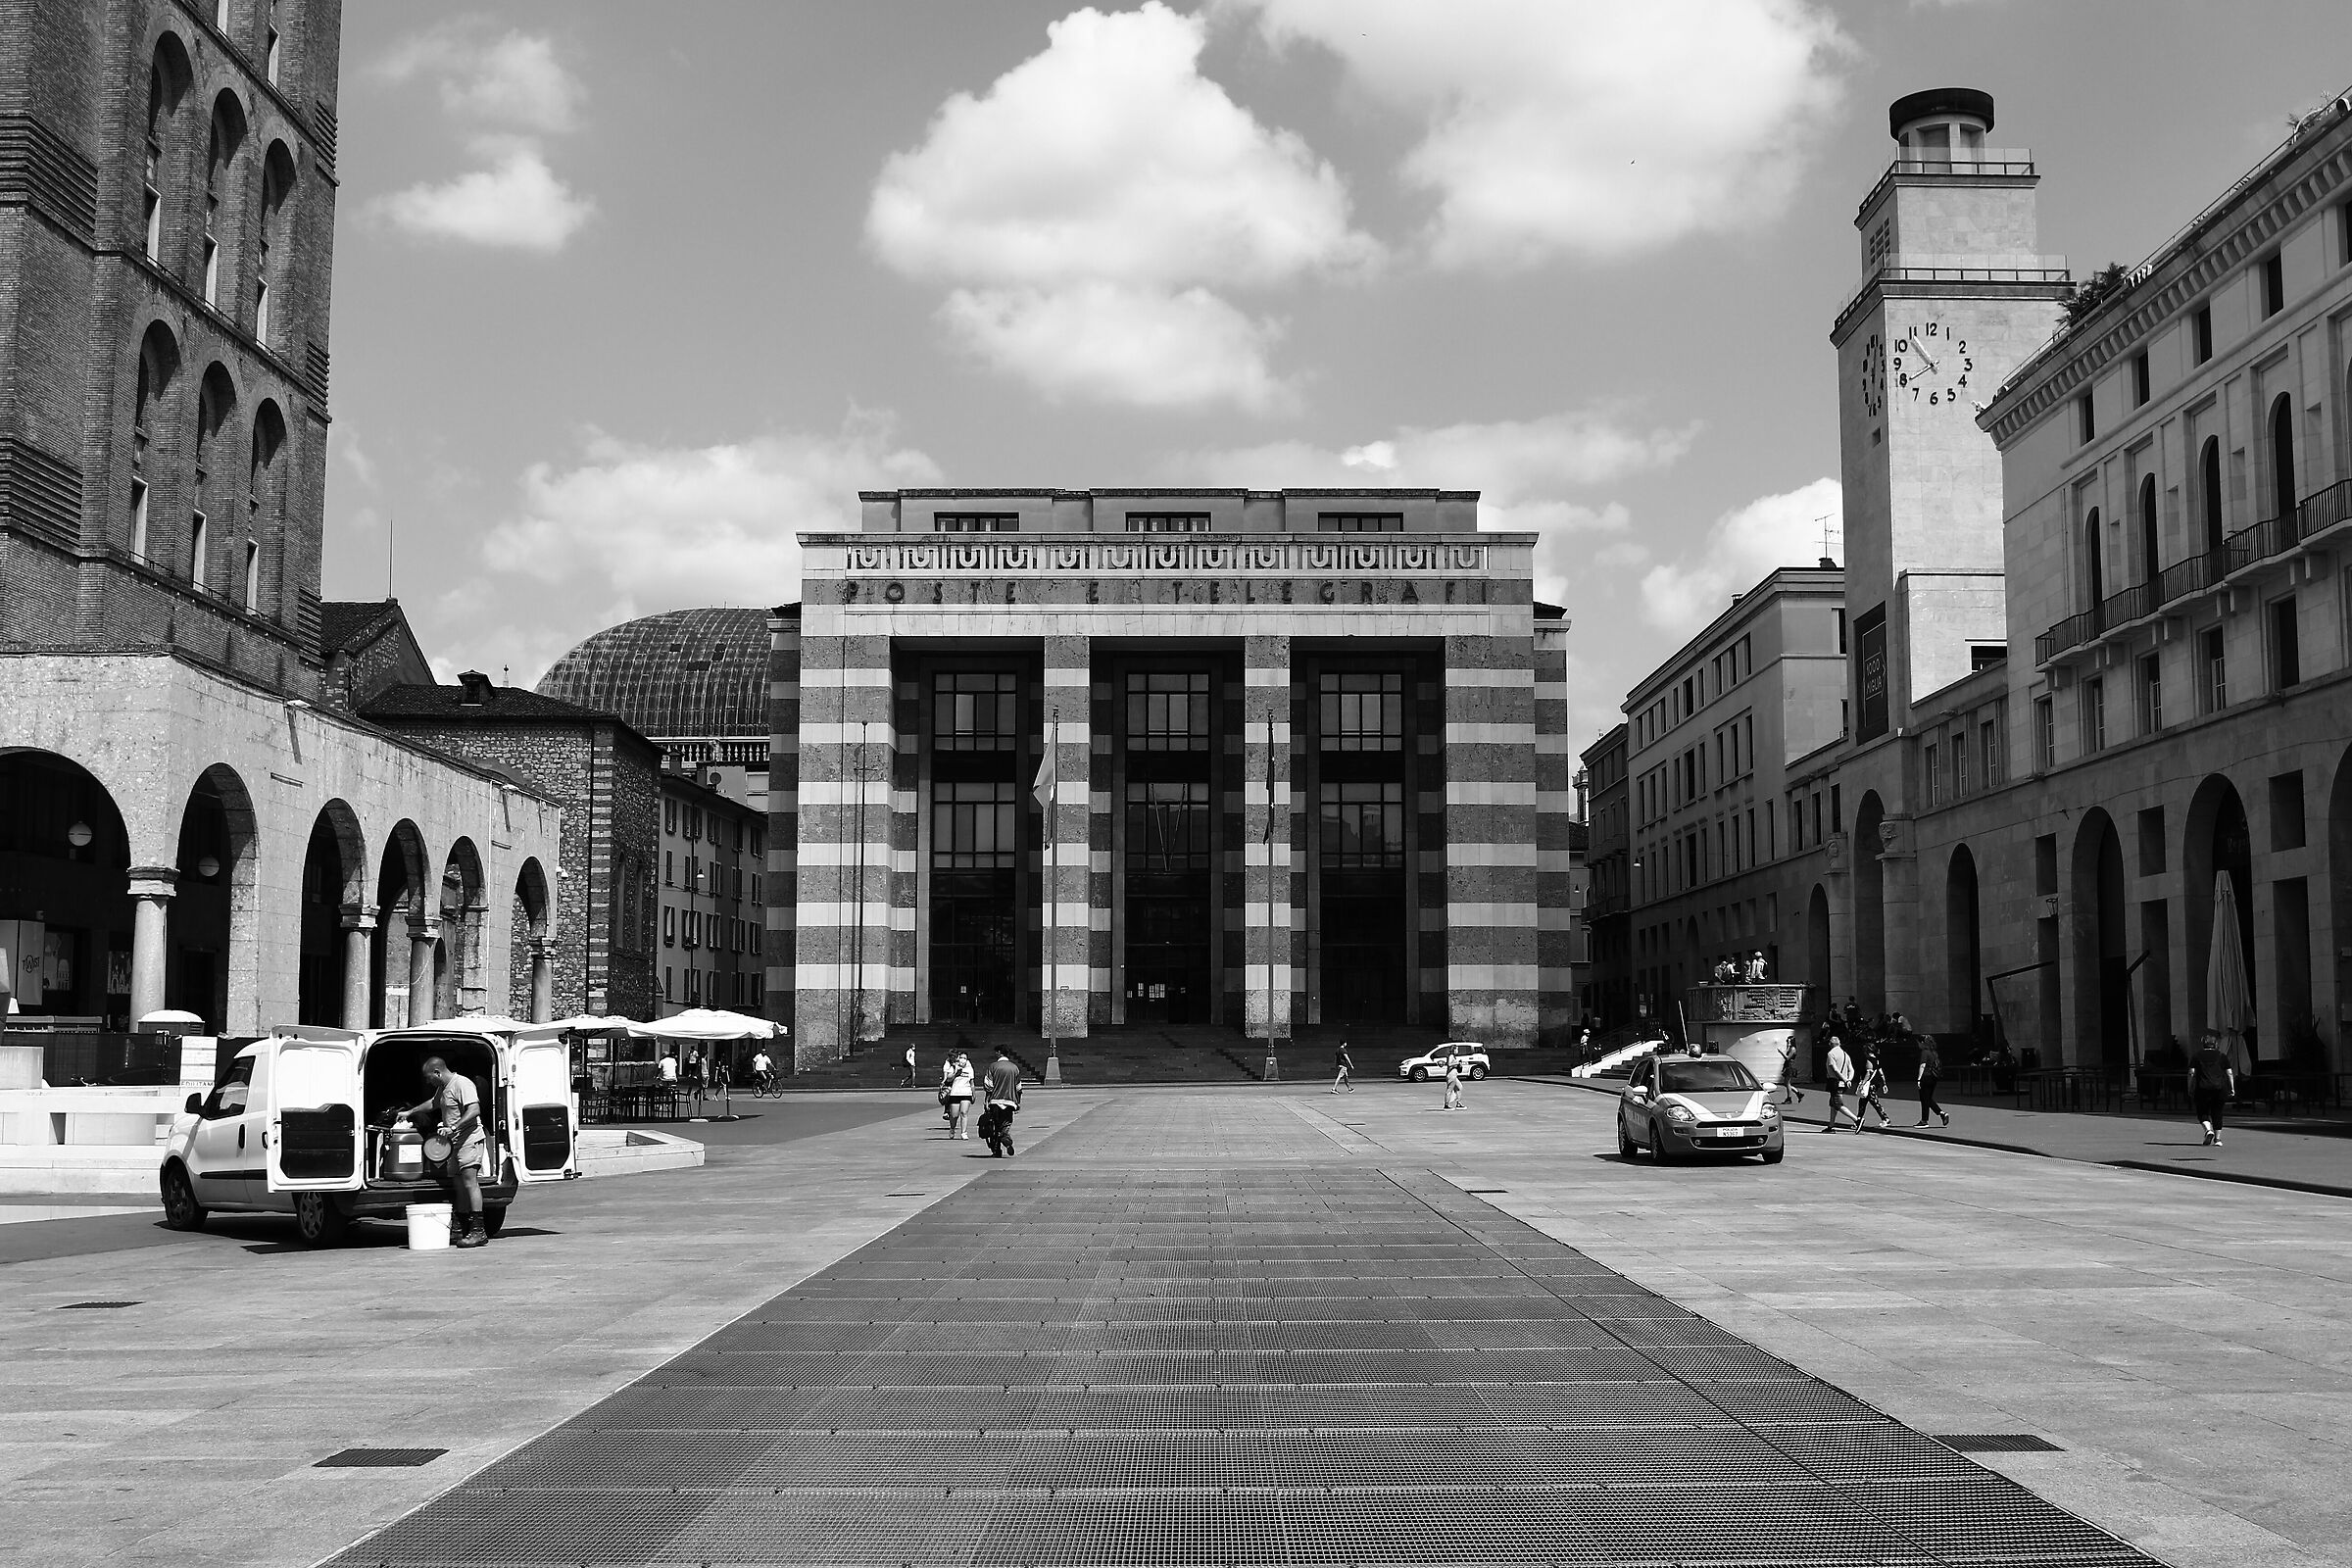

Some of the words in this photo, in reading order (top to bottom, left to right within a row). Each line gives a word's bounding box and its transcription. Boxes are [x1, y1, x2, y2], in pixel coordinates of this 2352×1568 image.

[1909, 326, 1917, 340] 11
[1926, 322, 1937, 336] 12
[1946, 326, 1950, 341] 1
[1894, 339, 1908, 353] 10
[1958, 340, 1967, 354] 2
[1893, 357, 1902, 370] 9
[1964, 358, 1973, 371] 3
[1899, 372, 1908, 387] 8
[1958, 373, 1968, 388] 4
[1912, 387, 1920, 402] 7
[1930, 392, 1938, 406] 6
[1947, 388, 1956, 402] 5
[845, 581, 1017, 604] POSTE
[1088, 581, 1100, 604] E
[1172, 581, 1488, 604] TELEGRAFI
